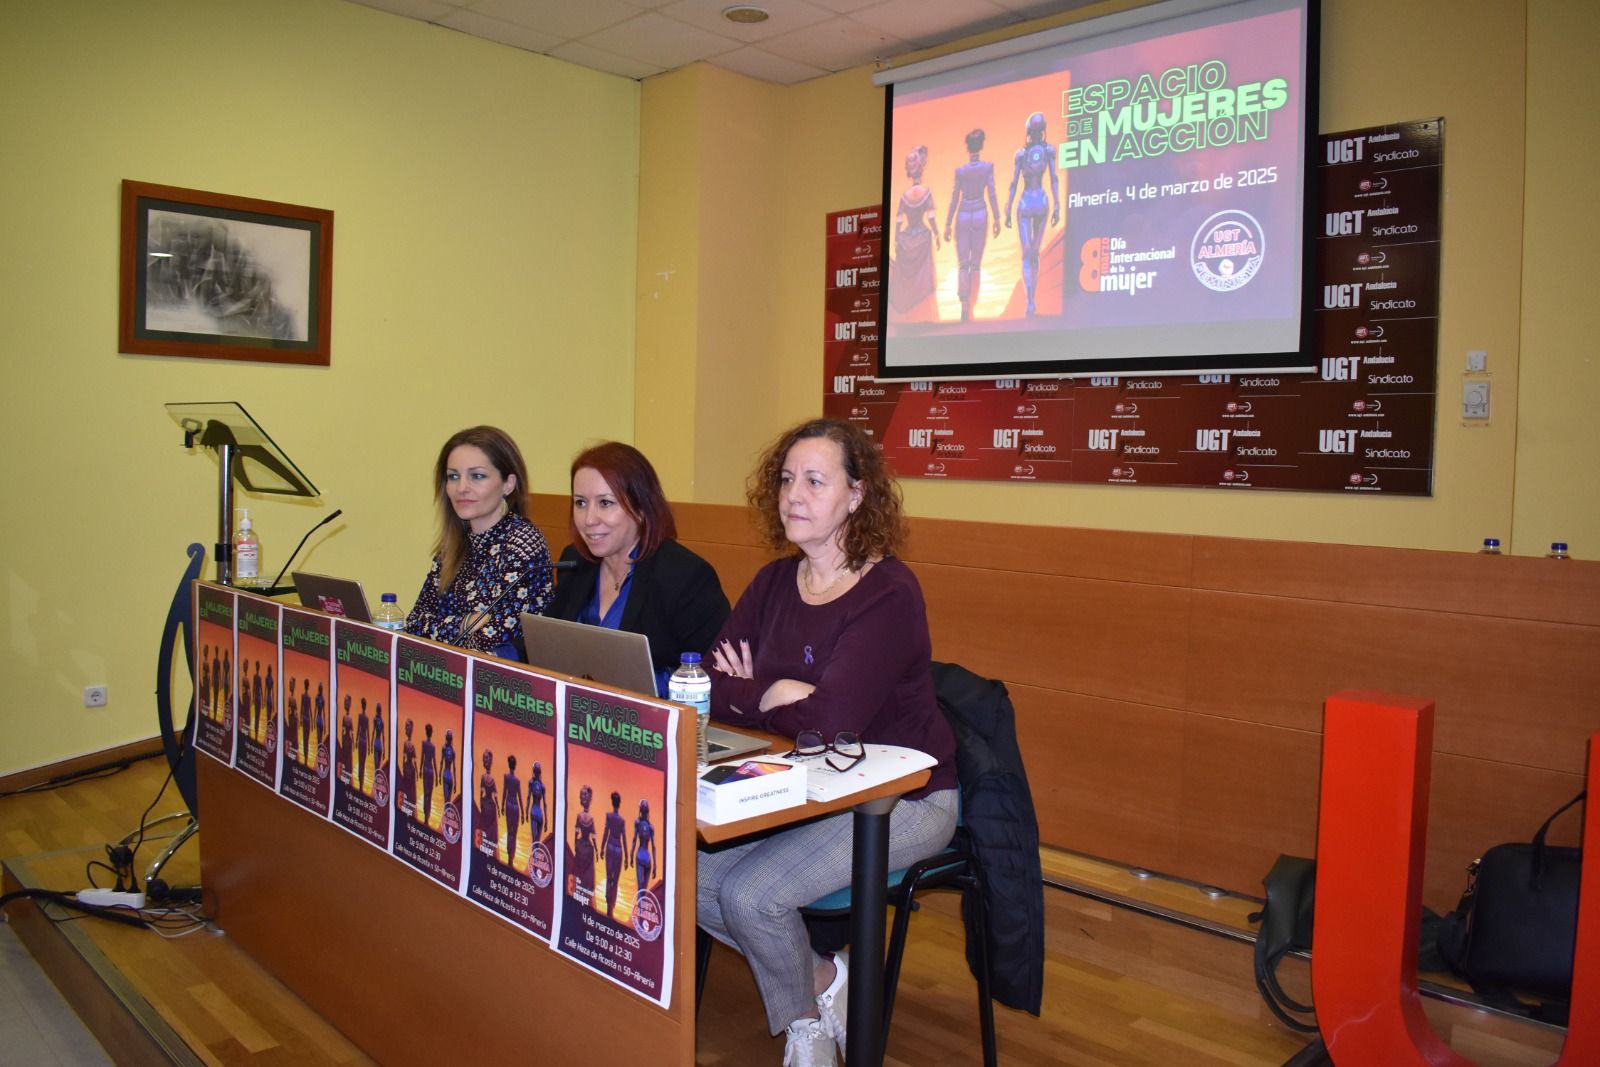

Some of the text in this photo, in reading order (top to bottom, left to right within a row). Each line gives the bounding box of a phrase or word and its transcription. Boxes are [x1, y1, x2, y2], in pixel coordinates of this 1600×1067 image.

[1062, 60, 1226, 118] ESPACIO
[1066, 79, 1287, 137] DE MUJERES
[1059, 137, 1106, 168] EN
[1327, 137, 1366, 164] UGT
[1373, 149, 1419, 162] Sindicato
[1126, 186, 1136, 200] 4
[1139, 183, 1157, 199] de
[1161, 176, 1209, 197] marzo
[1213, 173, 1232, 191] de
[1237, 166, 1277, 188] 2025
[837, 215, 859, 234] UGT
[1326, 210, 1365, 236] UGT
[1372, 224, 1418, 236] Sindicato
[1110, 237, 1126, 250] Día
[1213, 229, 1241, 243] UGT
[1079, 237, 1101, 292] 8
[836, 268, 858, 288] UGT
[1100, 266, 1157, 295] mujer
[1323, 283, 1363, 308] UGT
[1370, 300, 1416, 310] Sindicato
[835, 321, 857, 340] UGT
[1321, 357, 1360, 381] UGT
[1368, 374, 1414, 384] Sindicato
[834, 375, 856, 393] UGT
[1027, 383, 1059, 392] Sindicato
[1127, 381, 1162, 389] Sindicato
[1240, 378, 1280, 386] Sindicato
[909, 429, 933, 447] UGT
[993, 429, 1020, 448] UGT
[1088, 429, 1119, 450] UGT
[1196, 429, 1231, 451] UGT
[1319, 429, 1358, 453] UGT
[1024, 444, 1056, 453] Sindicato
[1124, 445, 1160, 454] Sindicato
[1237, 447, 1277, 456] Sindicato
[1365, 448, 1410, 458] Sindicato
[291, 626, 329, 646] MUJERES
[337, 648, 350, 662] EN
[347, 640, 389, 664] MUJERES
[398, 668, 413, 683] EN
[411, 660, 464, 689] MUJERES
[475, 693, 493, 711] EN
[490, 685, 554, 717] MUJERES
[570, 694, 639, 725] ESPACIO
[568, 723, 590, 743] EN
[586, 713, 663, 749] MUJERES
[739, 787, 789, 804] INSPIRE GREATNESS
[522, 881, 535, 894] 2025
[582, 912, 640, 949] 4 de marzo de 2025
[586, 931, 594, 942] De
[609, 944, 614, 952] a
[565, 937, 577, 949] Calle
[591, 950, 597, 959] de
[598, 953, 617, 969] Acosta
